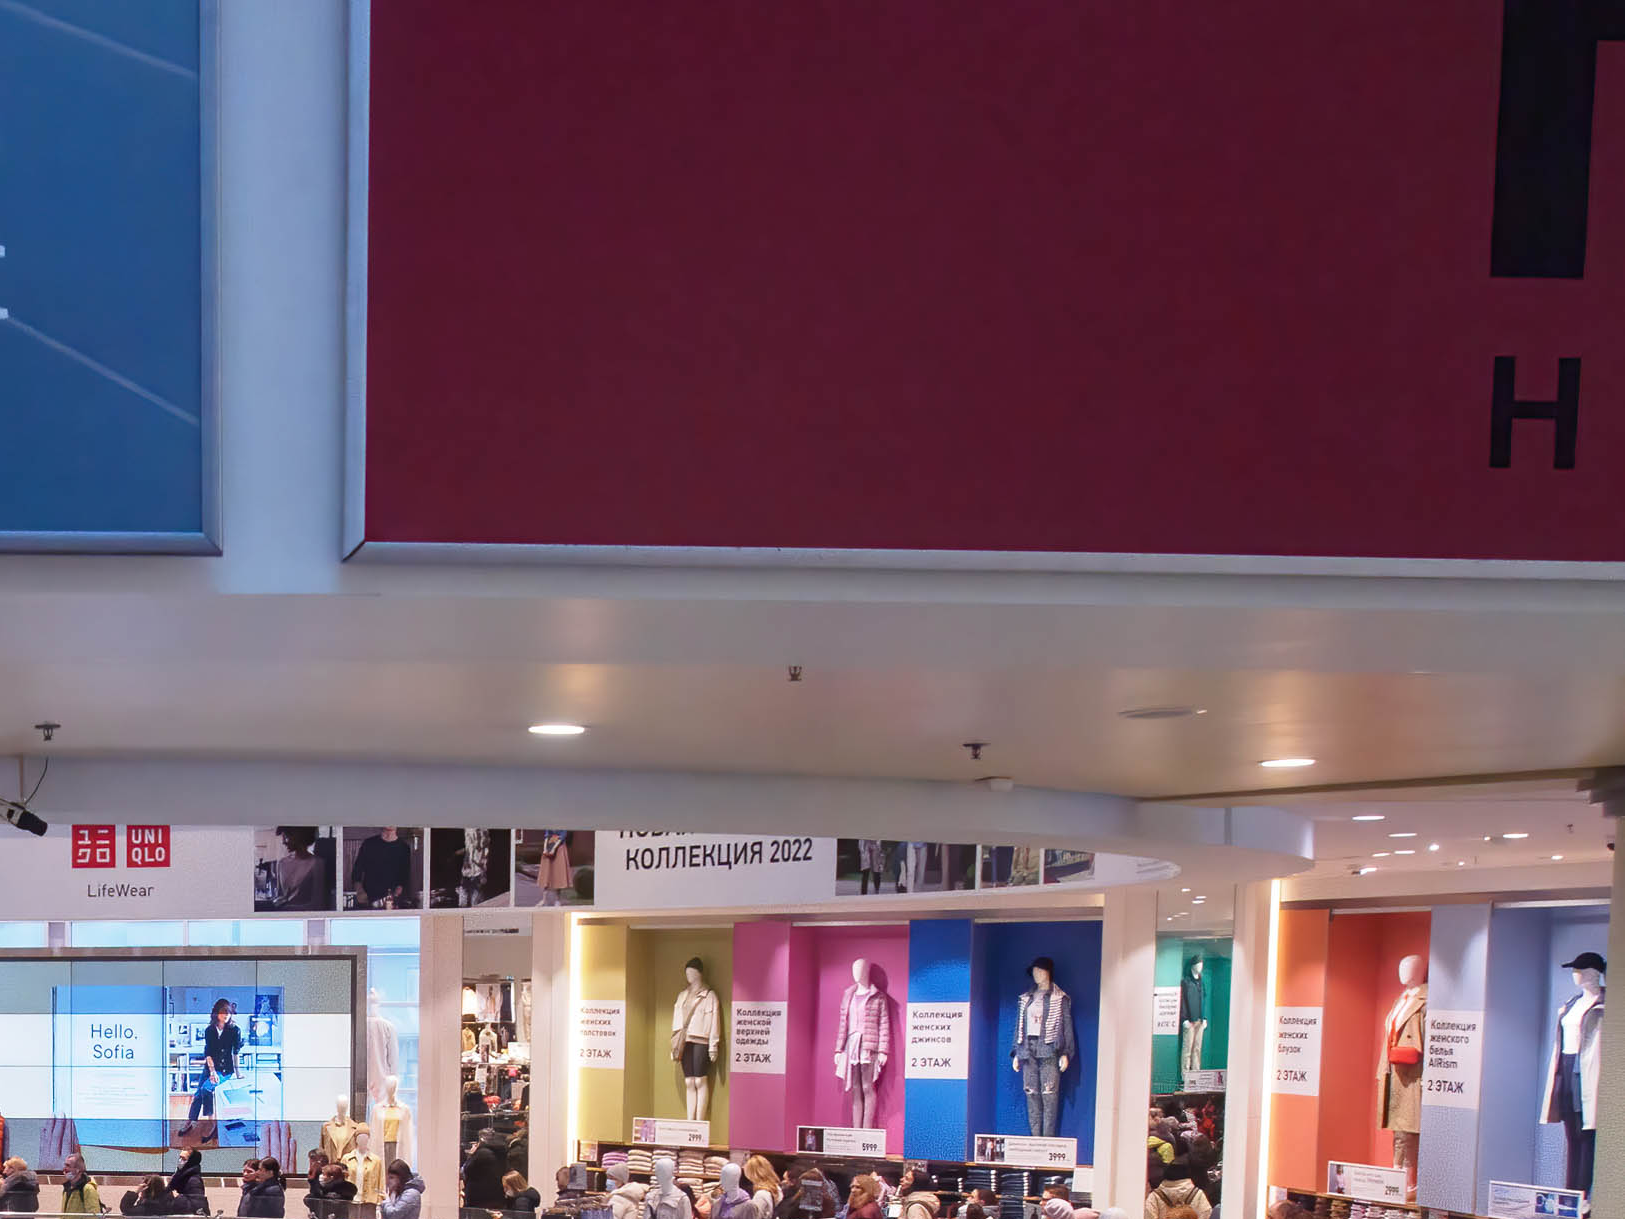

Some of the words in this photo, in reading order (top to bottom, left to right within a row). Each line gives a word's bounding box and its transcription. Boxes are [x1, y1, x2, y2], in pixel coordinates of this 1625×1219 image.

[131, 828, 163, 844] UNI
[131, 846, 166, 865] QLO
[625, 841, 763, 871] КОЛЛЕКЦИЯ
[769, 837, 813, 864] 2022
[87, 883, 155, 898] LifeWear
[736, 1008, 782, 1017] Коллекция
[912, 1011, 963, 1019] Коллекция
[736, 1018, 772, 1026] женской
[1279, 1016, 1317, 1025] Коллекция
[1430, 1019, 1476, 1031] Коллекция
[736, 1027, 770, 1036] верхней
[1278, 1031, 1308, 1039] женских
[735, 1037, 769, 1046] одежды
[911, 1036, 952, 1044] джинсов
[1430, 1034, 1470, 1044] женского
[93, 1044, 134, 1060] Sofia
[579, 1049, 585, 1058] 2
[586, 1049, 612, 1058] ЭТАЖ
[1429, 1046, 1454, 1056] белья
[735, 1053, 741, 1062] 2
[743, 1053, 771, 1063] ЭТАЖ
[911, 1057, 917, 1067] 2
[920, 1057, 952, 1067] ЭТАЖ
[1428, 1058, 1458, 1069] AIRism
[1276, 1070, 1282, 1080] 2
[1283, 1070, 1307, 1081] ЭТАЖ
[1427, 1080, 1433, 1091] 2
[1435, 1081, 1464, 1093] ЭТАЖ
[861, 1143, 878, 1152] 5999
[1048, 1152, 1066, 1161] 3999
